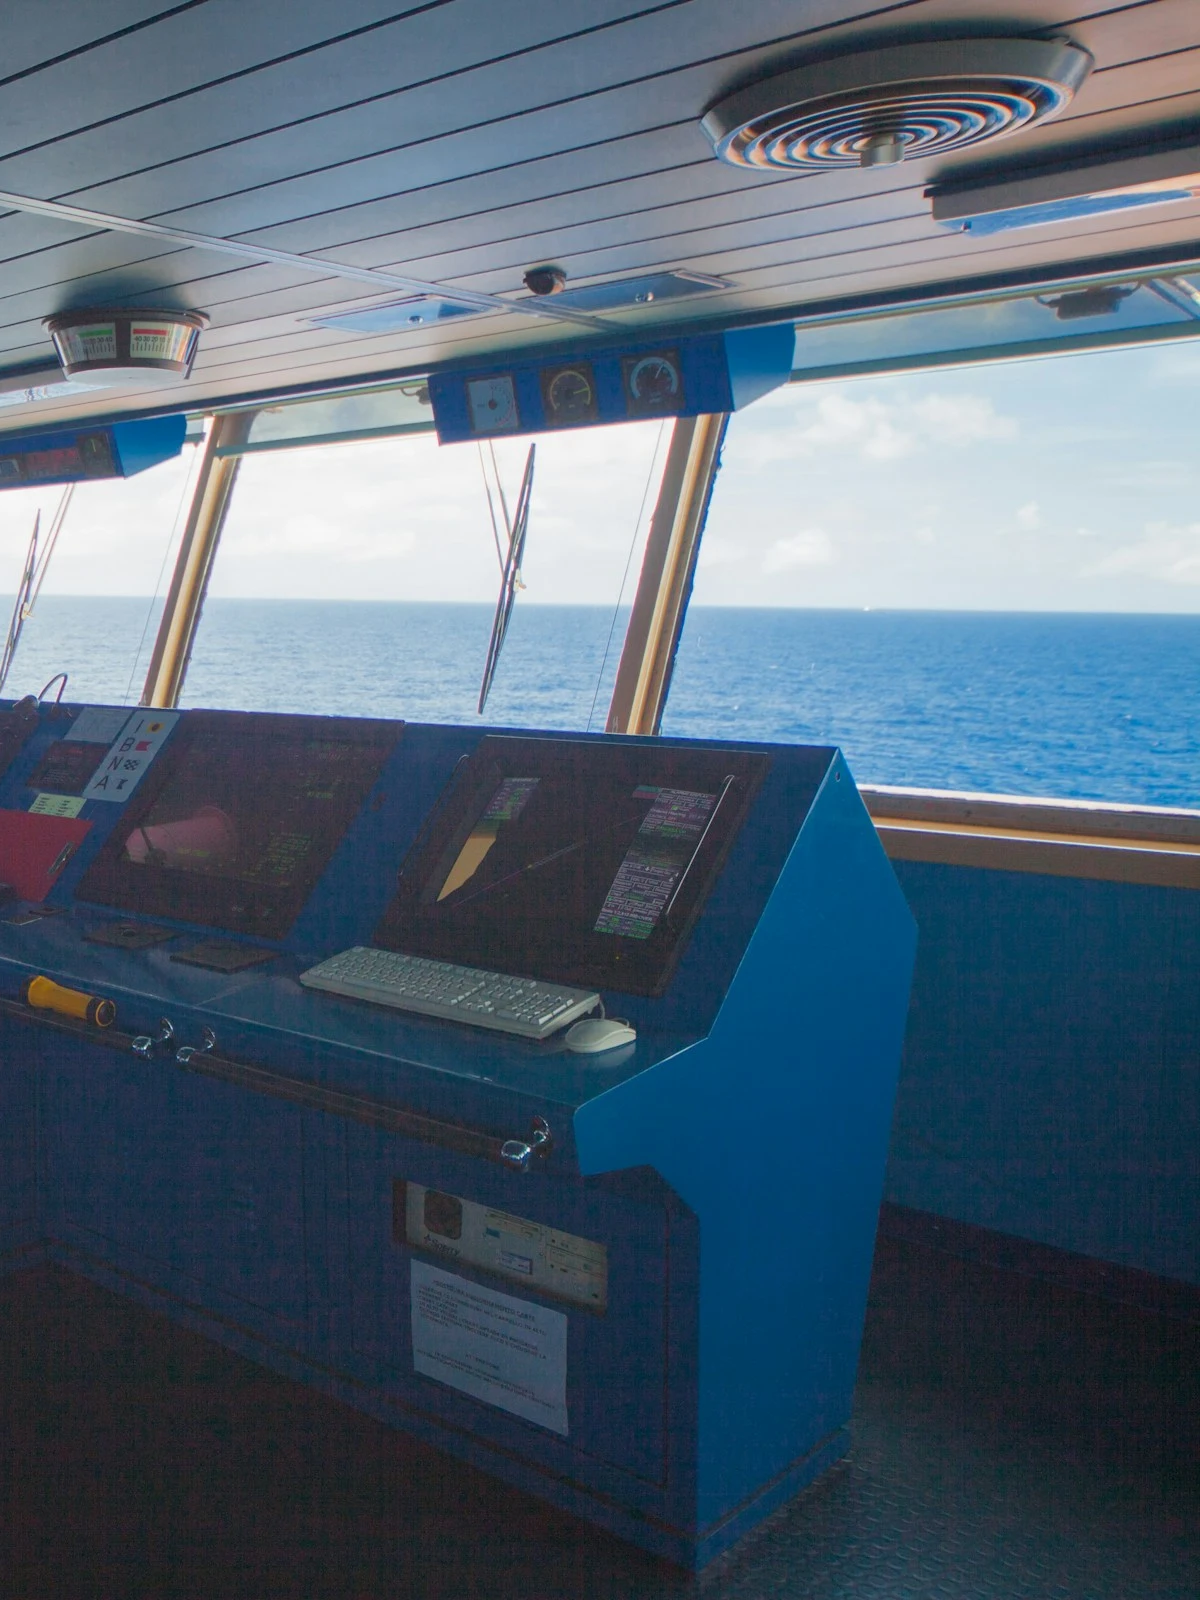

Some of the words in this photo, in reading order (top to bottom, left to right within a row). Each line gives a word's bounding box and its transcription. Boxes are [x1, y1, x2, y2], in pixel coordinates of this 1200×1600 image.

[134, 720, 144, 734] I
[119, 737, 135, 752] B
[107, 756, 121, 771] N
[93, 775, 108, 790] A
